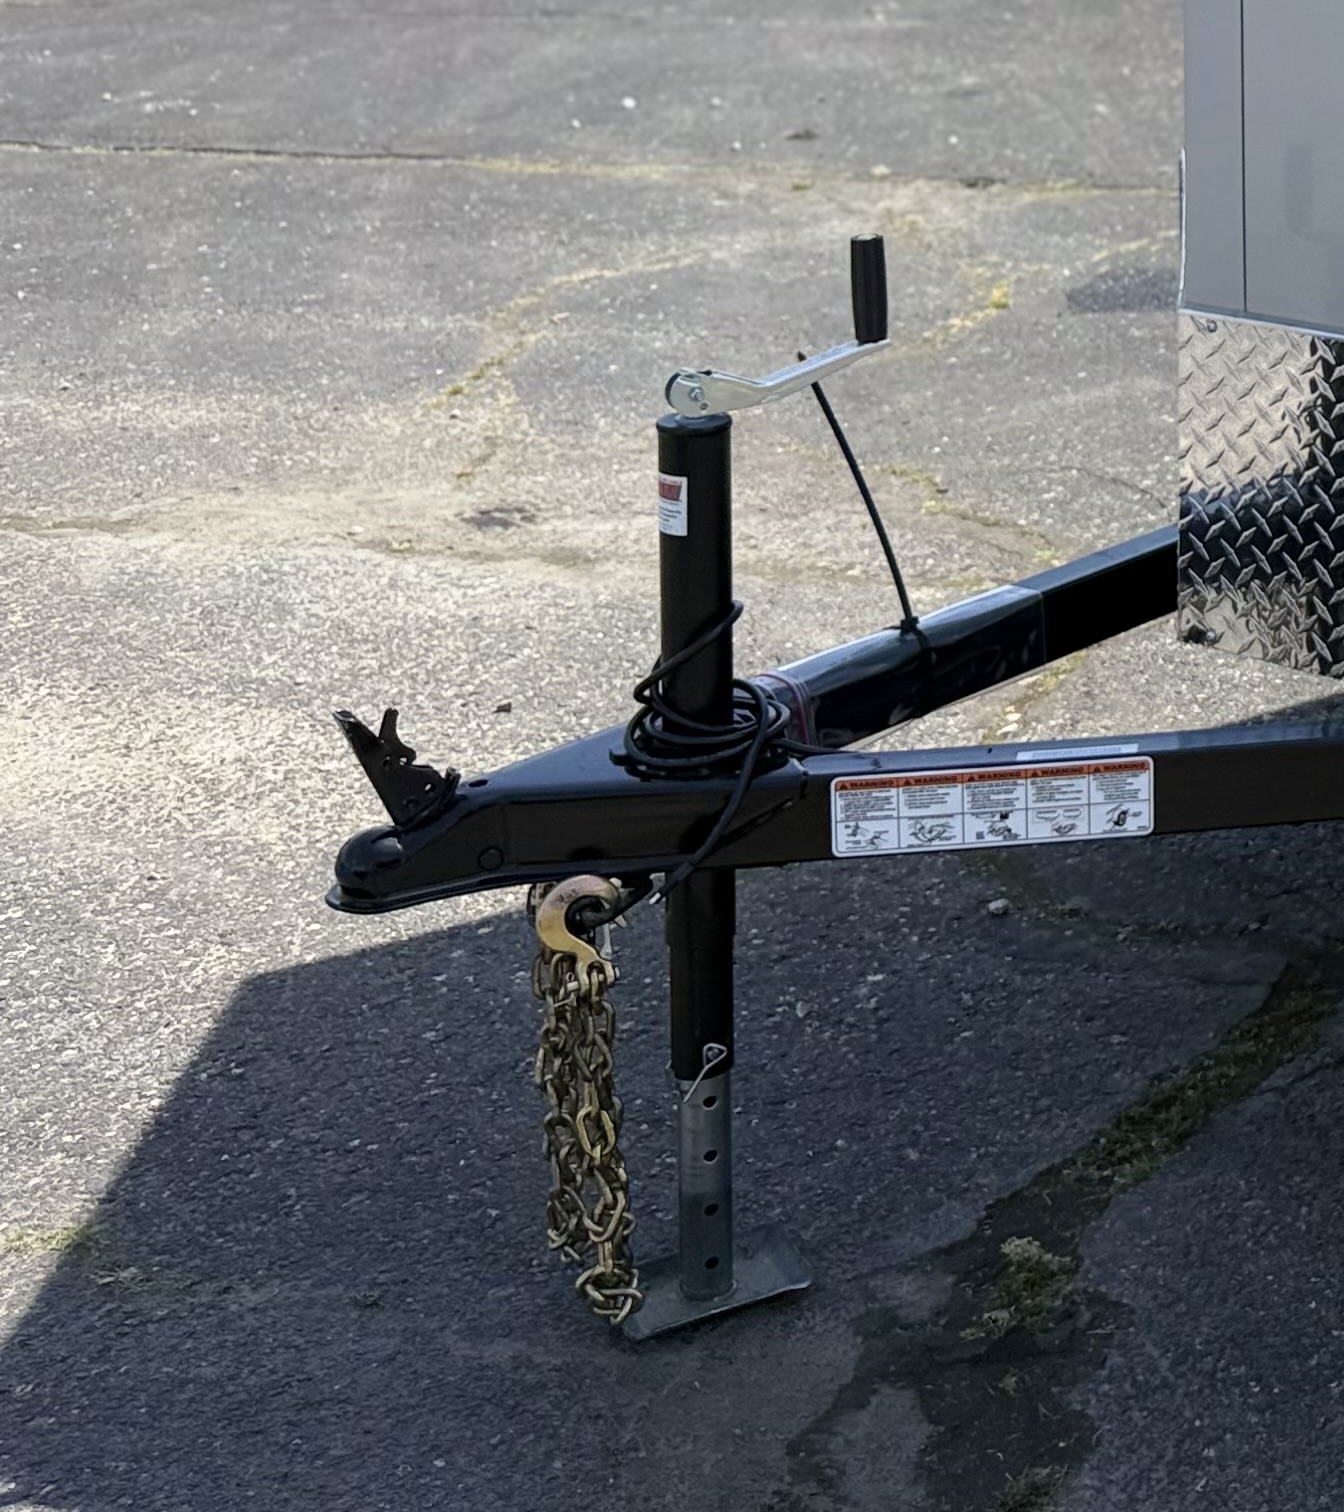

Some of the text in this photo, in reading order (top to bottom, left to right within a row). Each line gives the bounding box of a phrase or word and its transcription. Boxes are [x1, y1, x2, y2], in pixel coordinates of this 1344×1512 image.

[1041, 766, 1084, 775] WARNING
[1103, 762, 1146, 771] WARNING
[914, 776, 958, 784] WARNING
[978, 771, 1022, 780] WARNING
[850, 779, 894, 788] WARNING
